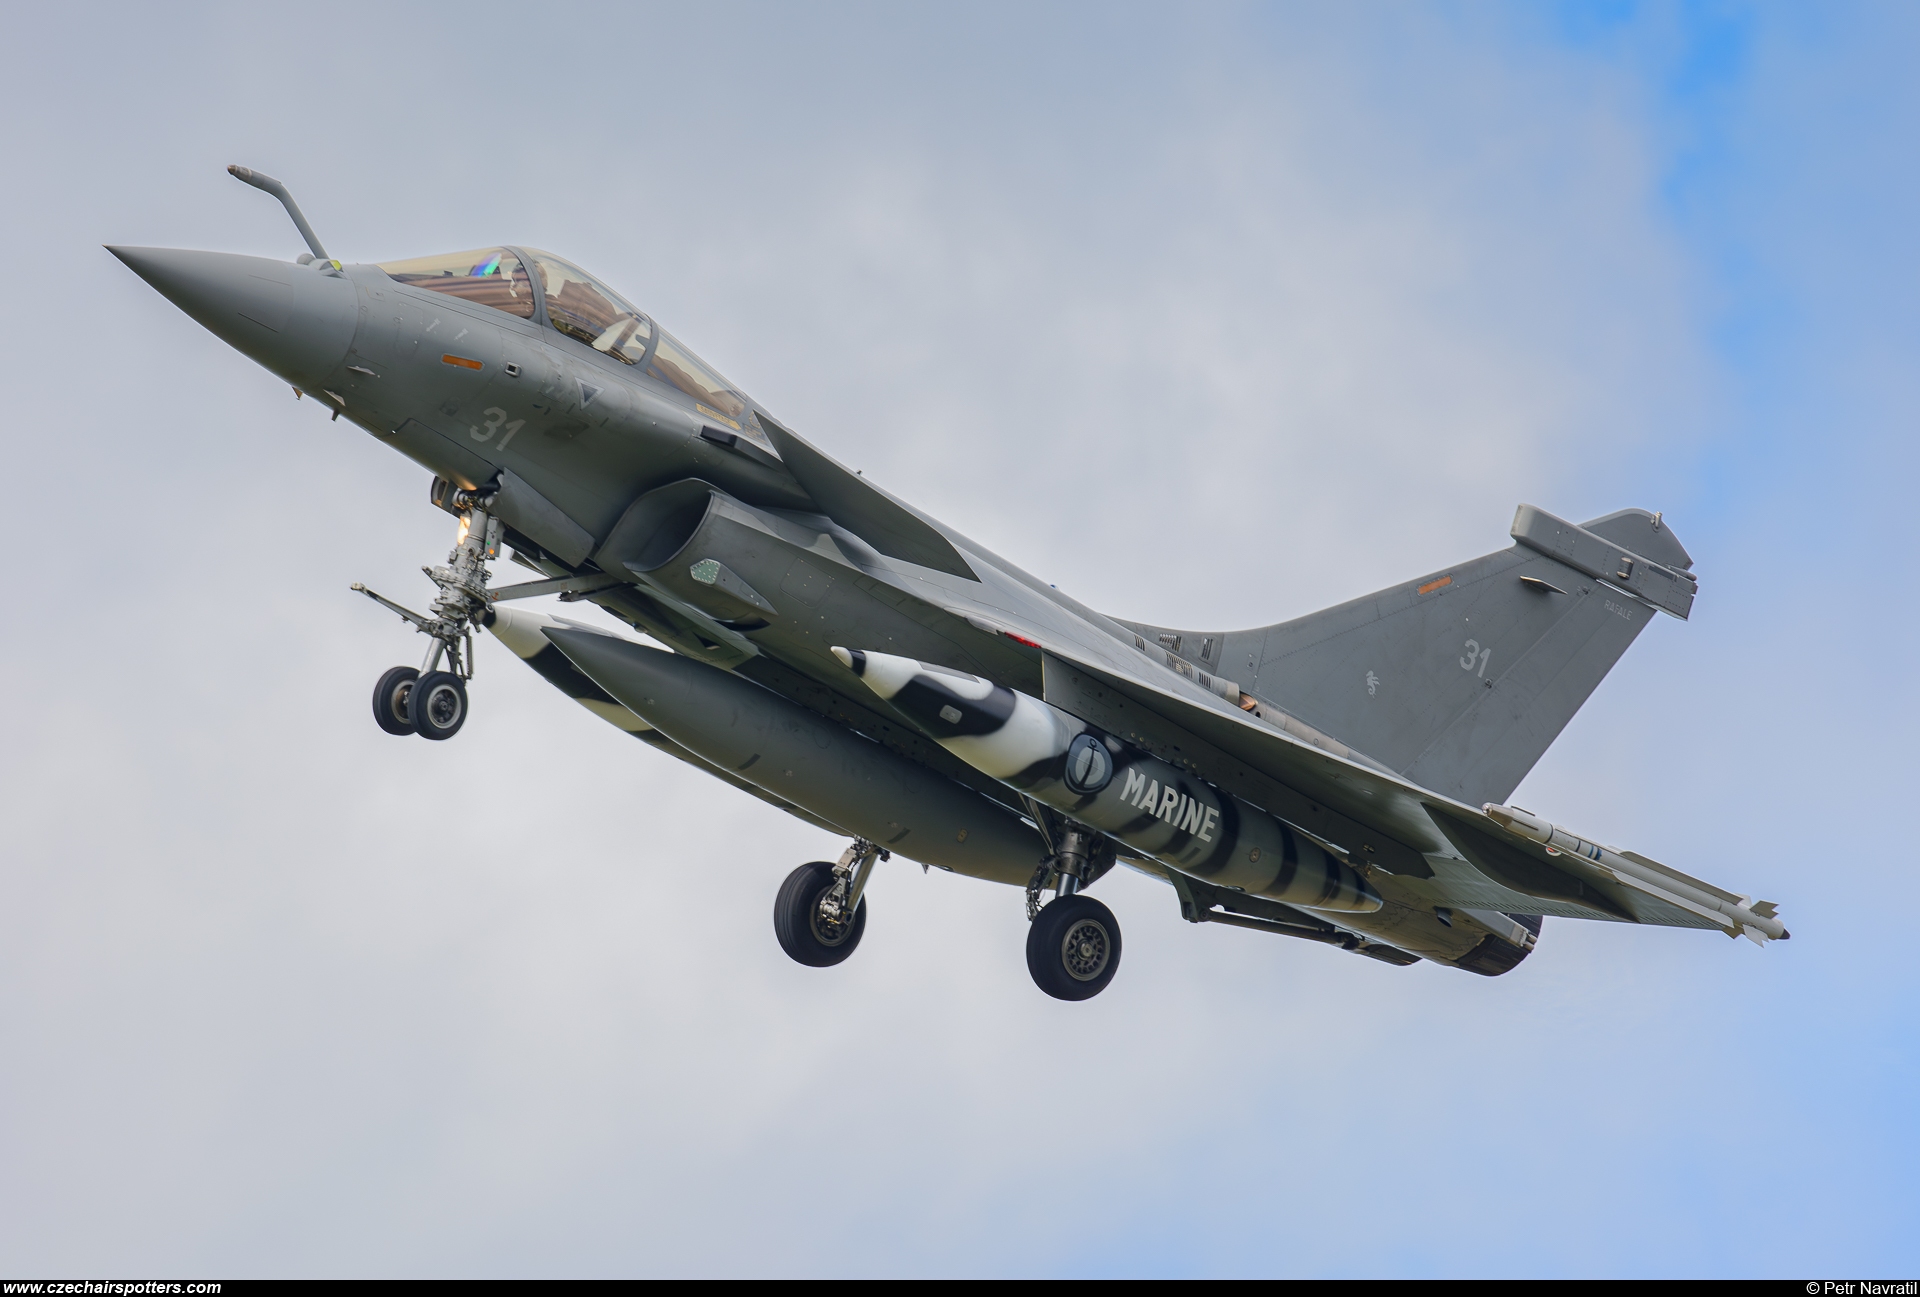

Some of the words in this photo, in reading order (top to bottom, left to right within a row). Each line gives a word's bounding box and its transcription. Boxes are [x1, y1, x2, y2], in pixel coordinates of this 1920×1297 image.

[470, 406, 527, 452] 31
[1603, 599, 1633, 621] RAFALE
[1459, 638, 1492, 679] 31
[1120, 766, 1220, 843] MARINE
